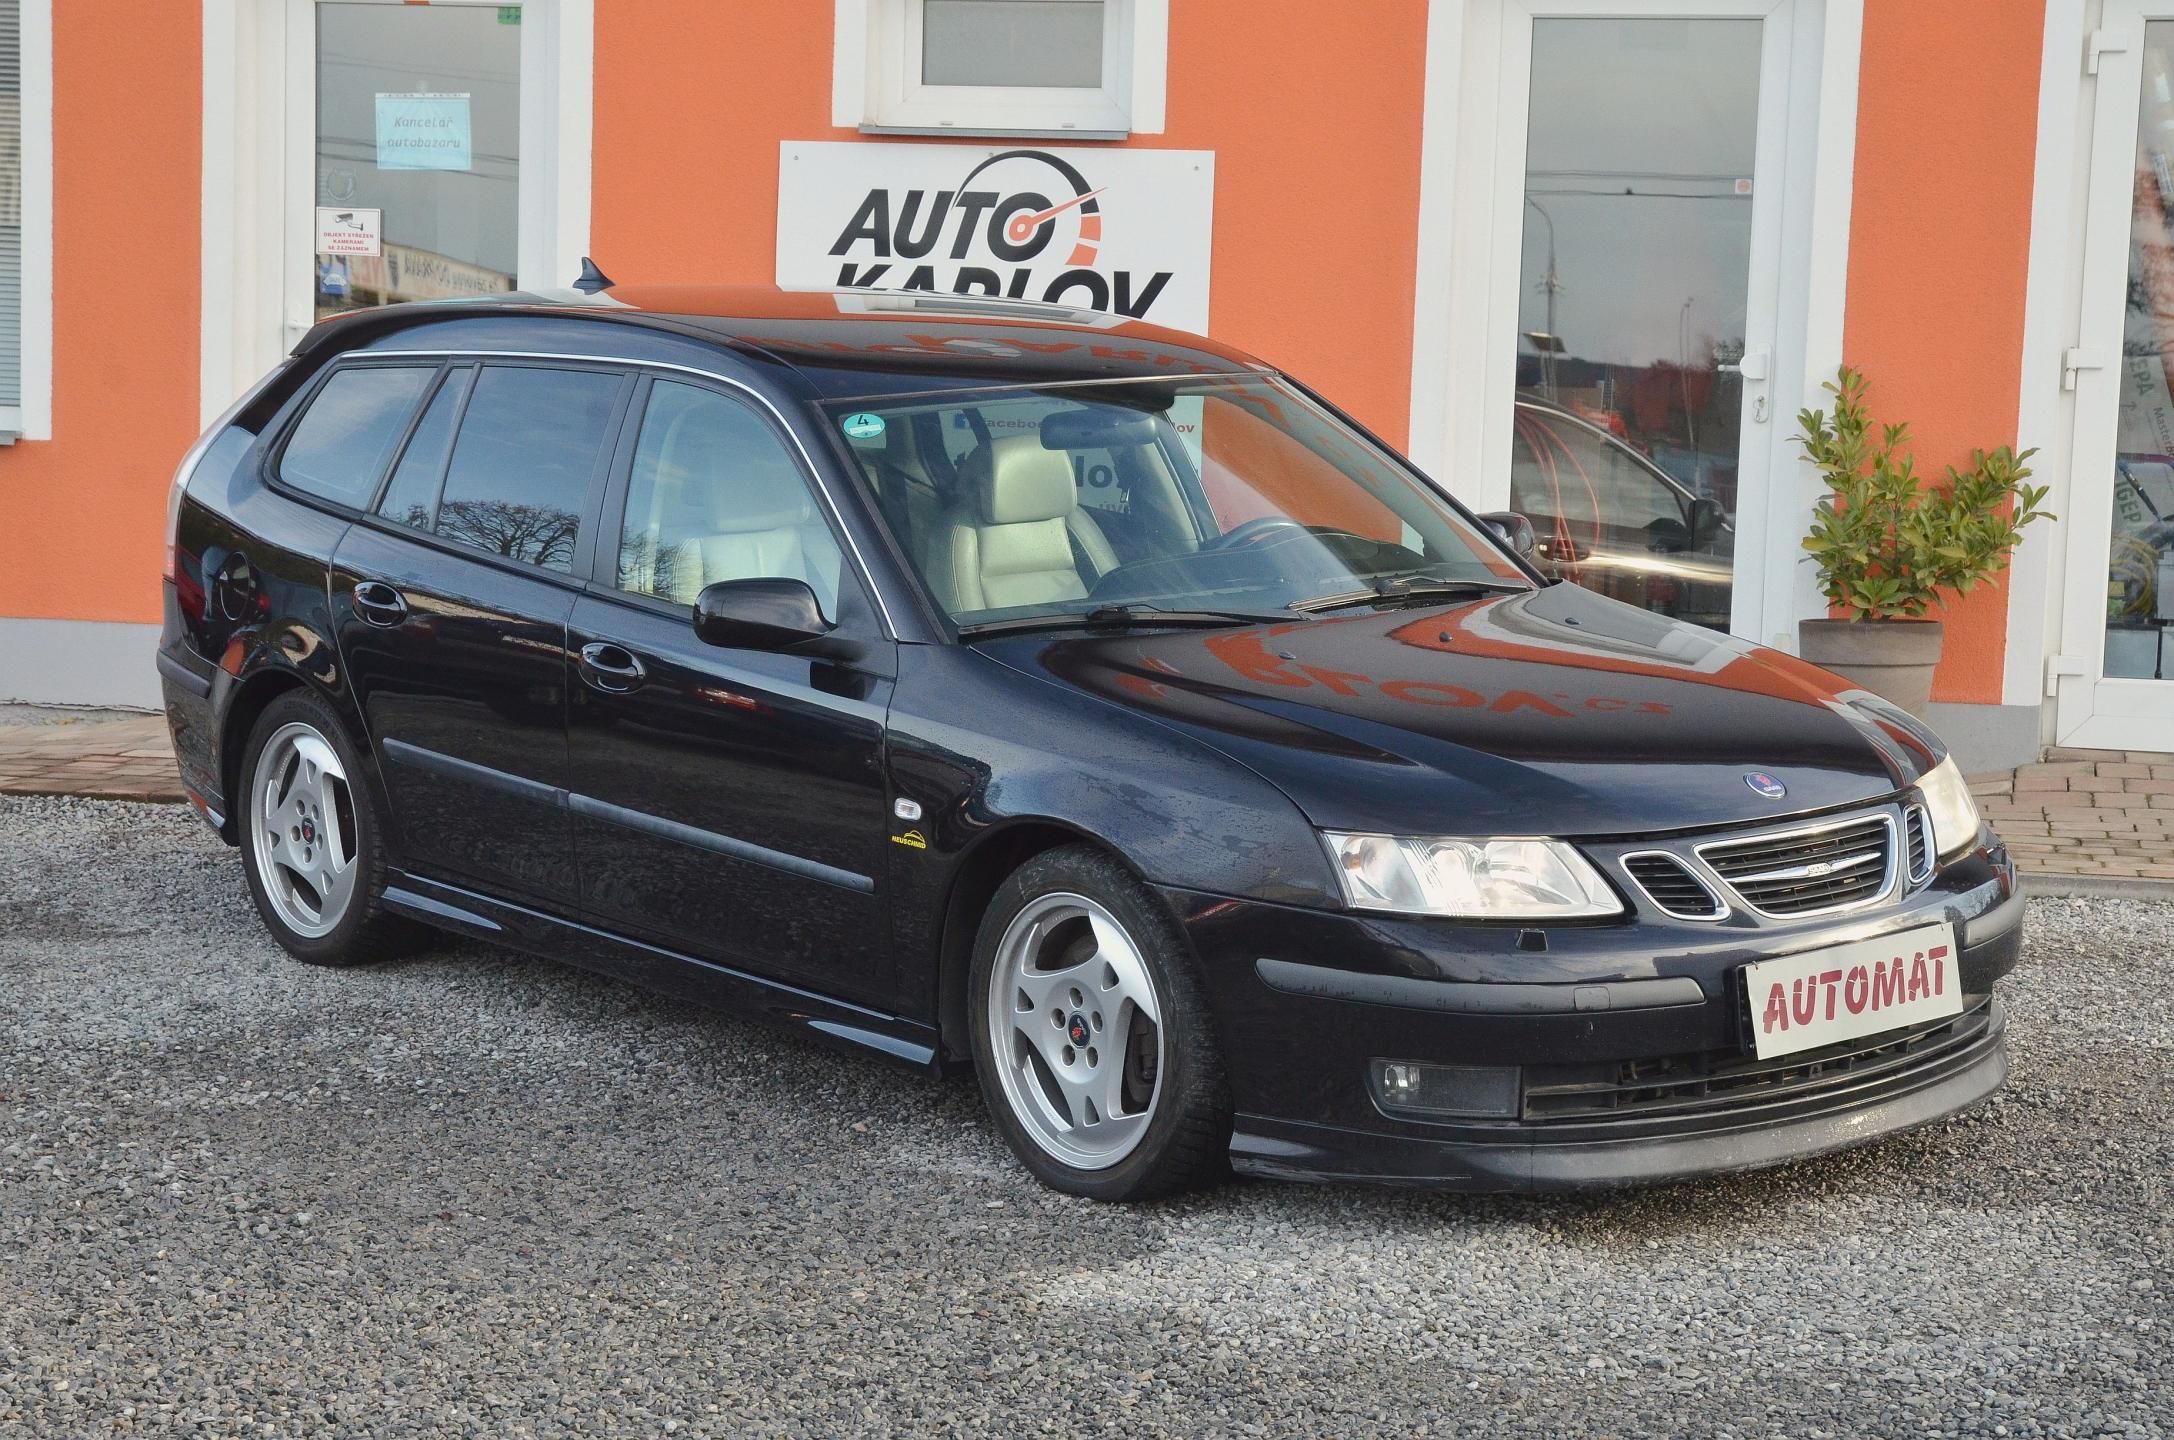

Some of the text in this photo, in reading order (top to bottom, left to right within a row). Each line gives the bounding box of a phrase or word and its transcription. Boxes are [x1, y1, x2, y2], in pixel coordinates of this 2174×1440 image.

[387, 136, 460, 148] autobazaru
[828, 188, 1056, 262] AUTO
[1763, 945, 1948, 1034] AUTOMAT
